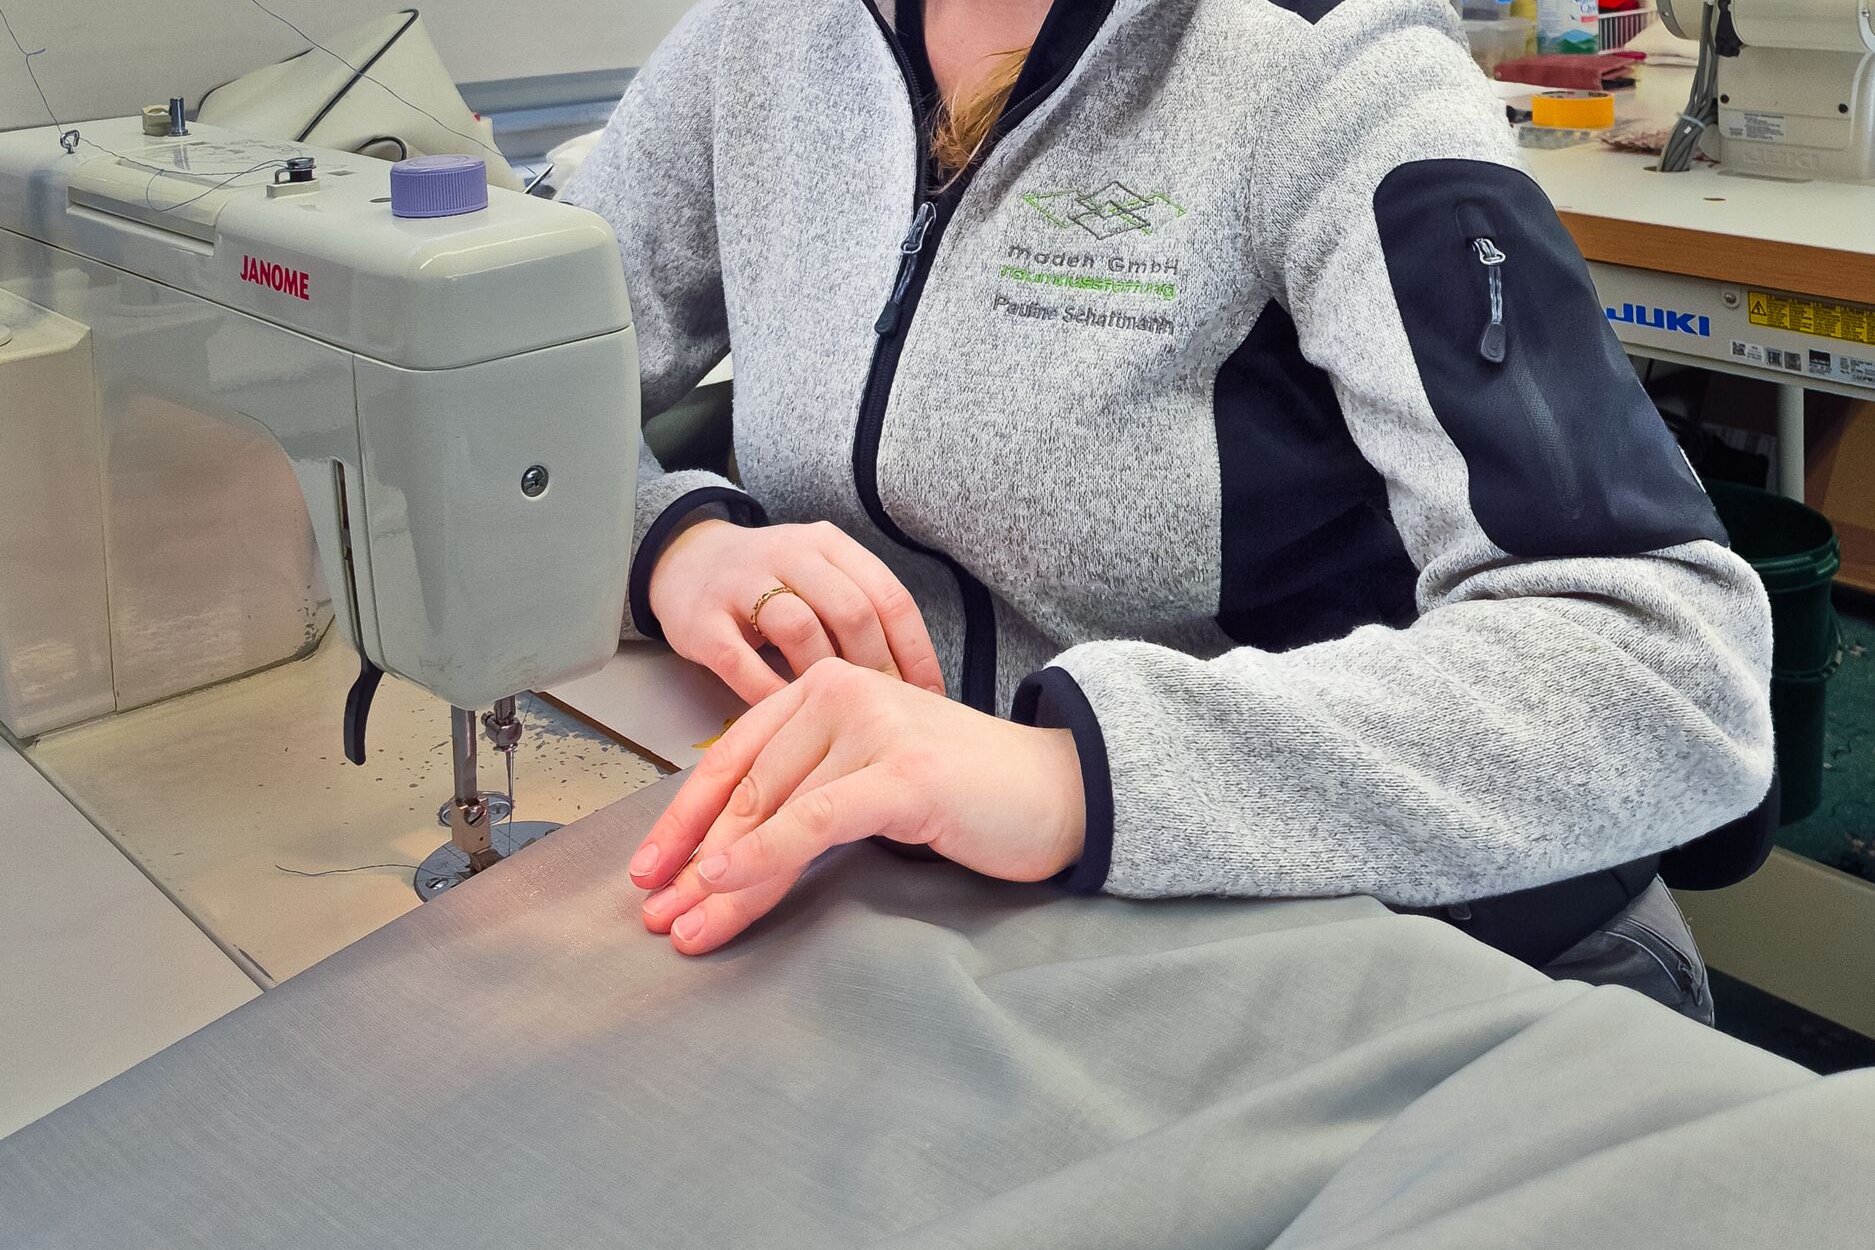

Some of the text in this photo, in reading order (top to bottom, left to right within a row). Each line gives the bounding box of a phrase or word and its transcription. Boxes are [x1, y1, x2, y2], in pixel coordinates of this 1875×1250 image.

[240, 254, 310, 301] JANOME
[1107, 257, 1179, 276] GmbH
[1605, 303, 1710, 337] JUKI
